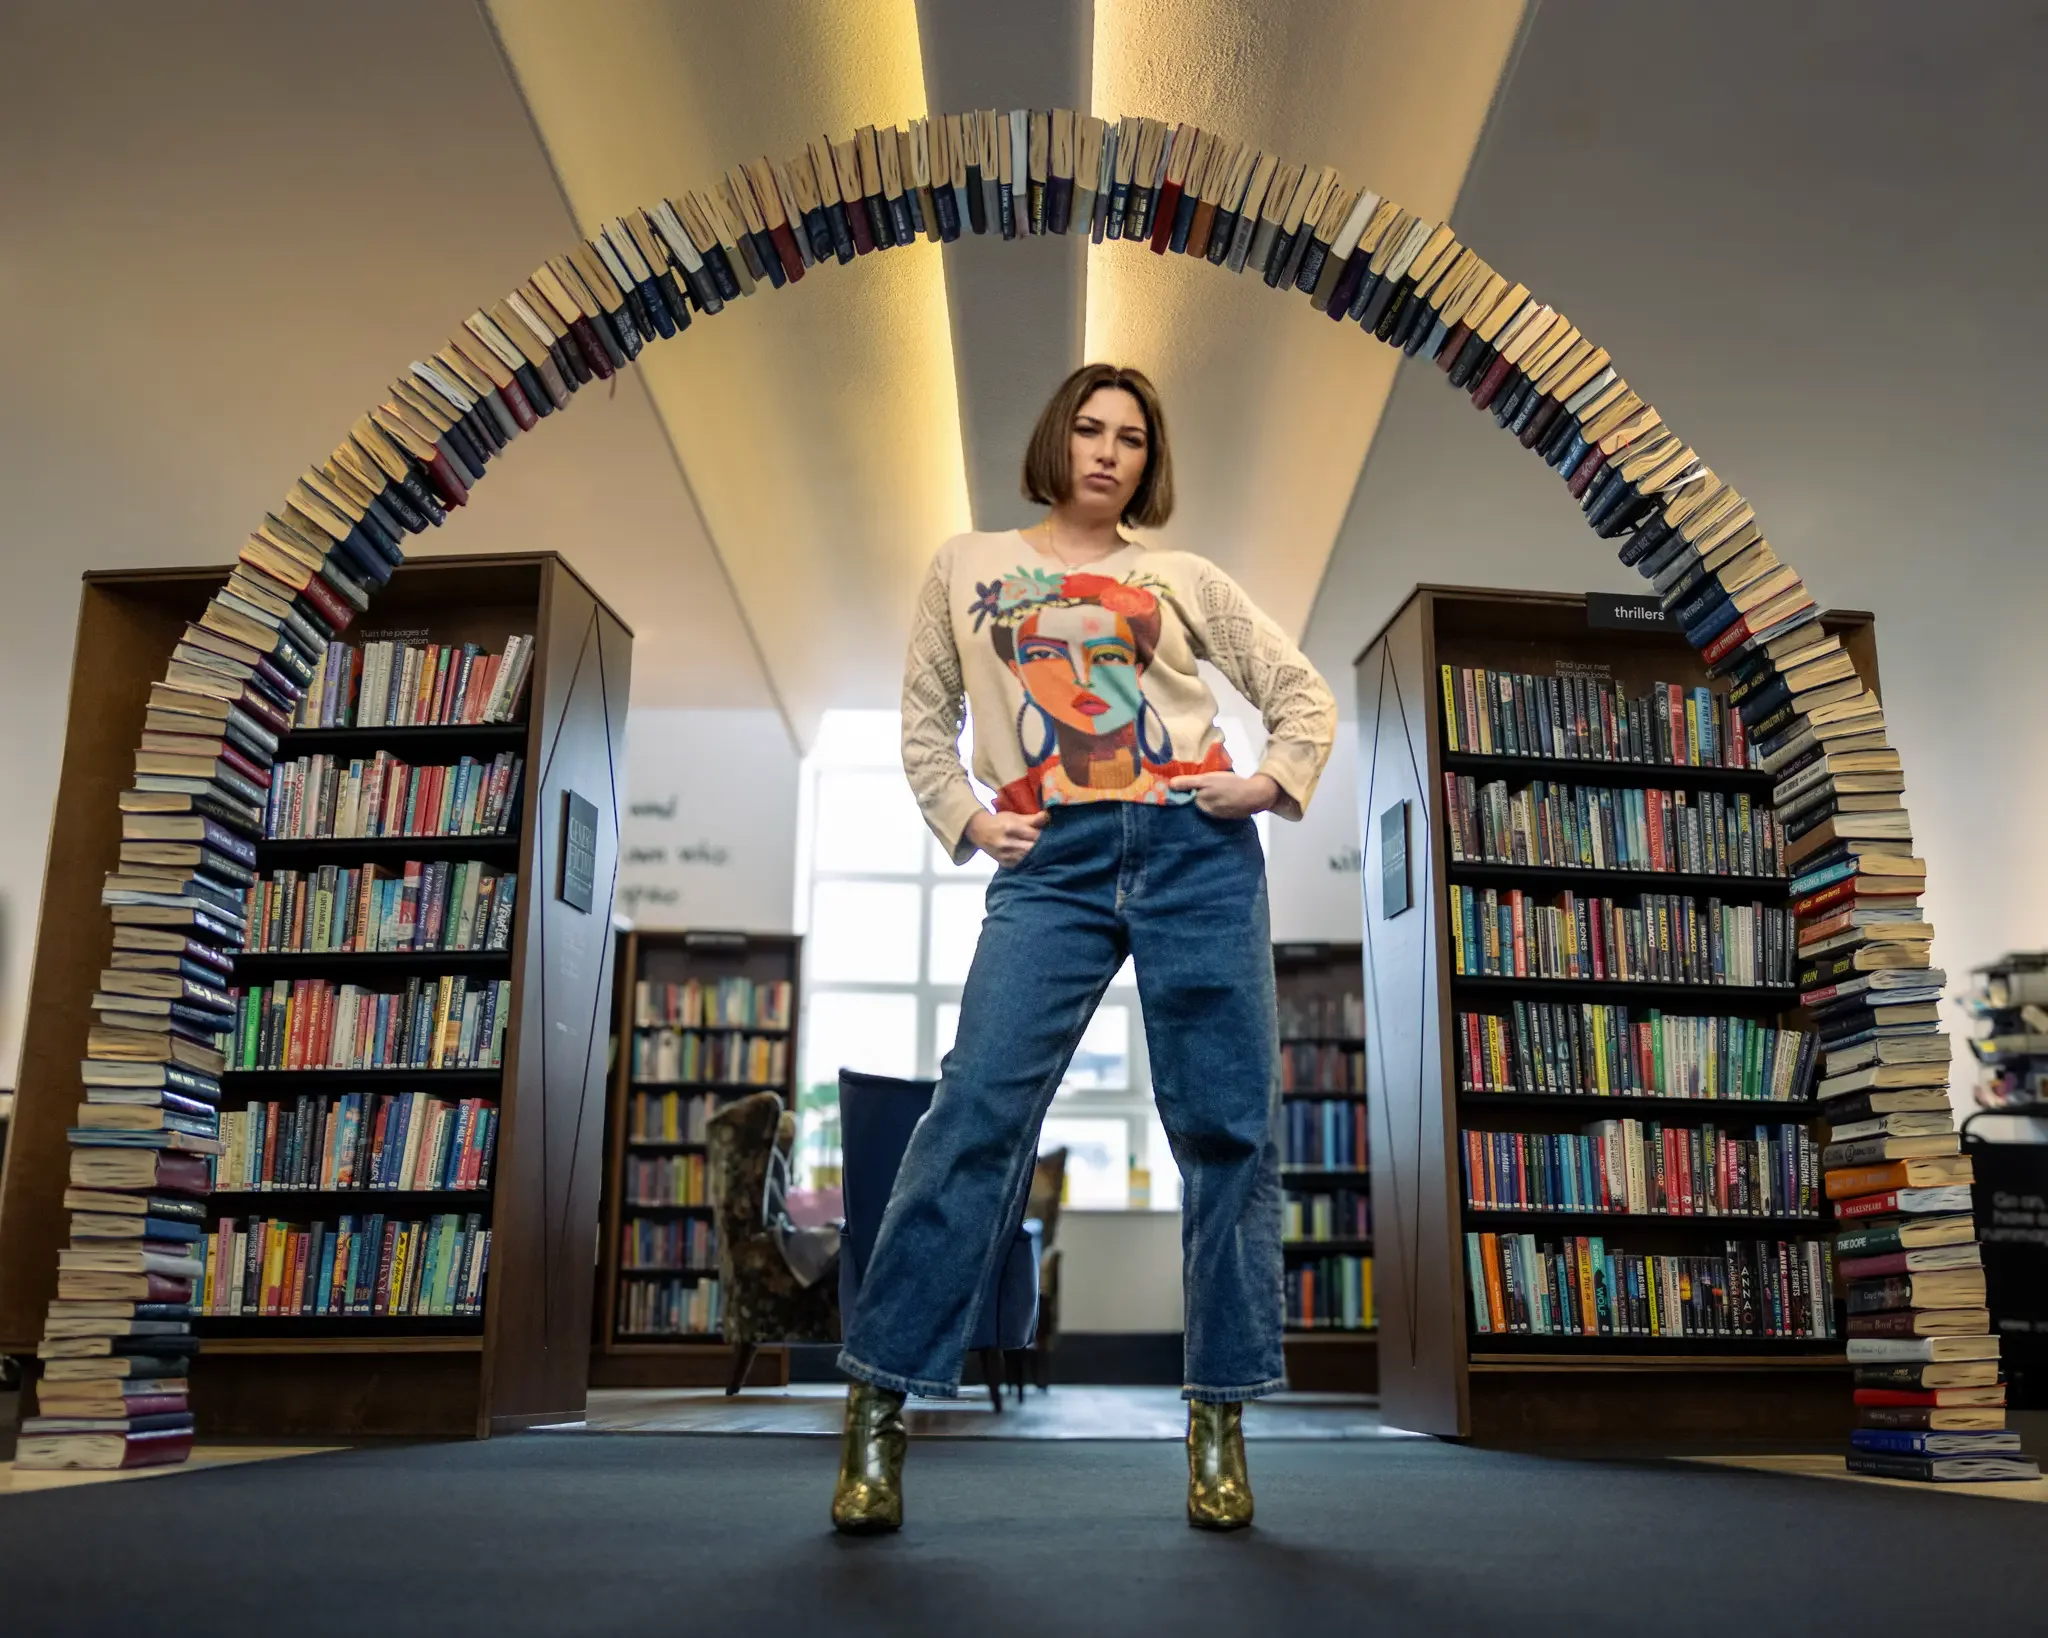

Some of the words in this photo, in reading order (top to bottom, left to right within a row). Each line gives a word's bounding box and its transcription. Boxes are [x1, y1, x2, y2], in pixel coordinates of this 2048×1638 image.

[1615, 606, 1664, 620] thrillers
[1682, 598, 1705, 620] INTRIGO
[380, 629, 393, 637] the
[395, 630, 419, 639] pages
[1556, 660, 1573, 668] Find
[1575, 662, 1592, 671] your
[1659, 696, 1667, 720] OLSEN
[457, 777, 465, 798] STARTUP
[292, 774, 305, 836] CONQUEST
[1648, 797, 1657, 825] HEADS
[1650, 826, 1659, 843] YOU
[1652, 845, 1660, 861] WIN
[317, 897, 327, 941] UNTAMEABLE
[1578, 901, 1586, 920] TALL
[1579, 922, 1587, 951] BONES
[1647, 910, 1655, 947] BALDACCI
[1659, 911, 1669, 951] BALDACCI
[1688, 912, 1697, 952] BALDACCI
[1700, 927, 1708, 958] BALDACCI
[1802, 971, 1818, 983] RUN
[295, 987, 305, 1006] Honey
[457, 978, 465, 999] MICHAEL
[423, 996, 431, 1017] VOLCANO
[292, 1013, 301, 1032] Spice
[420, 1018, 429, 1046] DAUGHTERS
[1489, 1017, 1497, 1030] ARE
[296, 1099, 305, 1126] Sebastian
[458, 1105, 469, 1125] SPILT
[294, 1127, 303, 1144] Barry
[455, 1126, 466, 1144] MILK
[1501, 1153, 1510, 1173] MAID
[1728, 1148, 1737, 1169] DOUBLE
[1799, 1139, 1809, 1186] BILLINGHAM
[1656, 1158, 1664, 1186] BLOOD
[1729, 1171, 1738, 1184] LIFE
[1810, 1154, 1818, 1188] BILLINGHAM
[1845, 1203, 1882, 1214] SHAKESPEARE
[247, 1224, 258, 1258] NORTHERN
[380, 1233, 393, 1263] GUEST
[1837, 1239, 1850, 1250] THE
[1849, 1236, 1867, 1248] DOPE
[462, 1239, 474, 1272] Storyteller
[1503, 1249, 1512, 1268] DARK
[1565, 1242, 1574, 1267] SWEET
[1789, 1246, 1798, 1269] DEADLY
[1824, 1250, 1832, 1262] THE
[246, 1259, 255, 1273] SPY
[1636, 1261, 1644, 1274] HARD
[377, 1264, 389, 1295] BOOK
[1505, 1269, 1514, 1293] WATER
[1638, 1282, 1646, 1298] NAILS
[1729, 1266, 1737, 1295] MURDER
[1772, 1273, 1780, 1299] UNDER
[1791, 1270, 1800, 1297] SECRETS
[1596, 1287, 1606, 1316] WOLF
[1732, 1297, 1738, 1305] IN
[1875, 1318, 1892, 1328] Boyd
